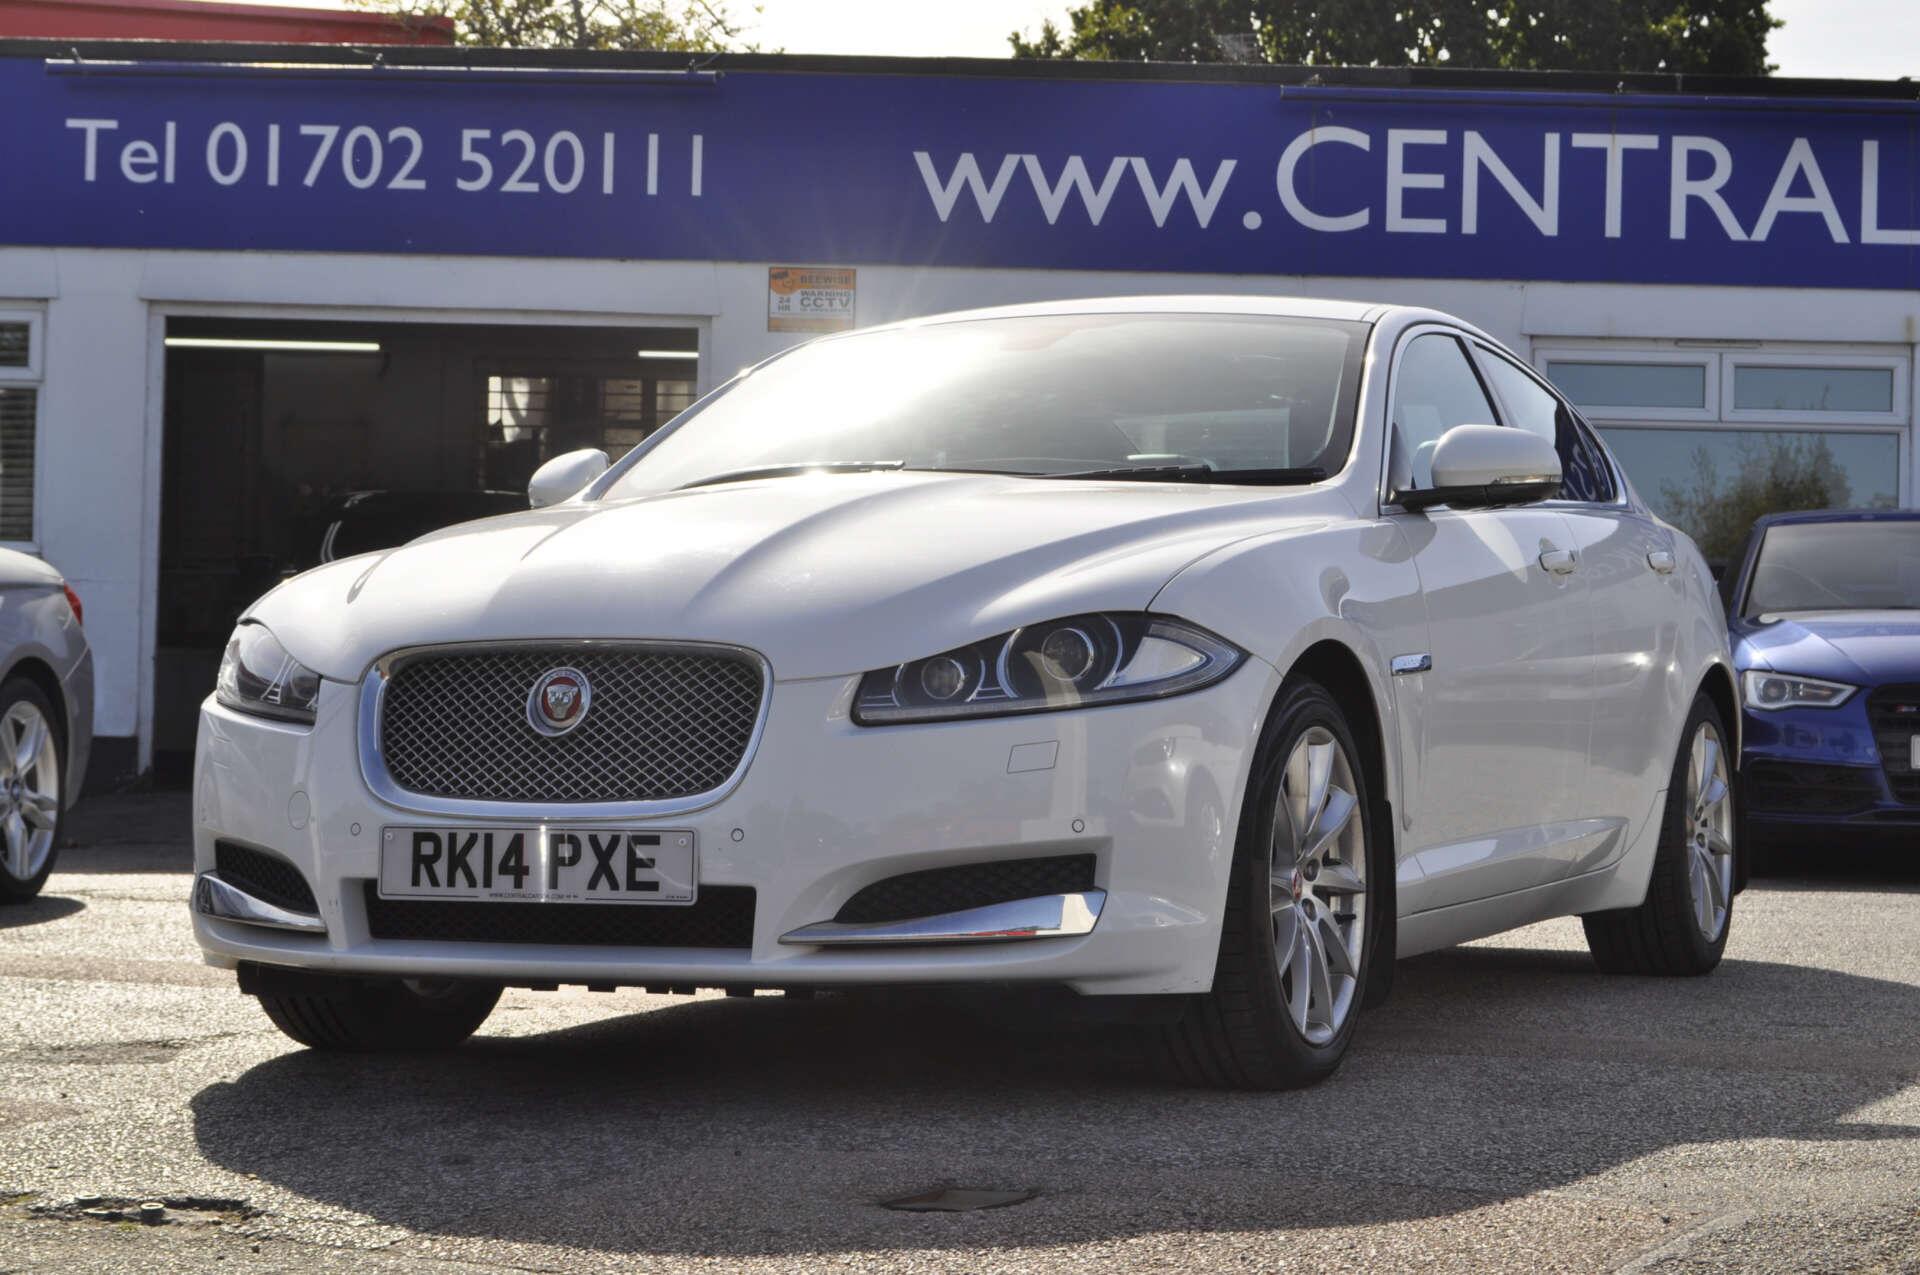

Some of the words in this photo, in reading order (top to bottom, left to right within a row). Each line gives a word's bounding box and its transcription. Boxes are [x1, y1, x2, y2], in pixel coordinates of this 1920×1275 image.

[65, 118, 176, 184] Tel
[206, 122, 427, 191] 01702
[455, 129, 704, 197] 520111
[800, 297, 851, 308] CCTV
[411, 831, 530, 890] RK14
[549, 833, 661, 892] PXE
